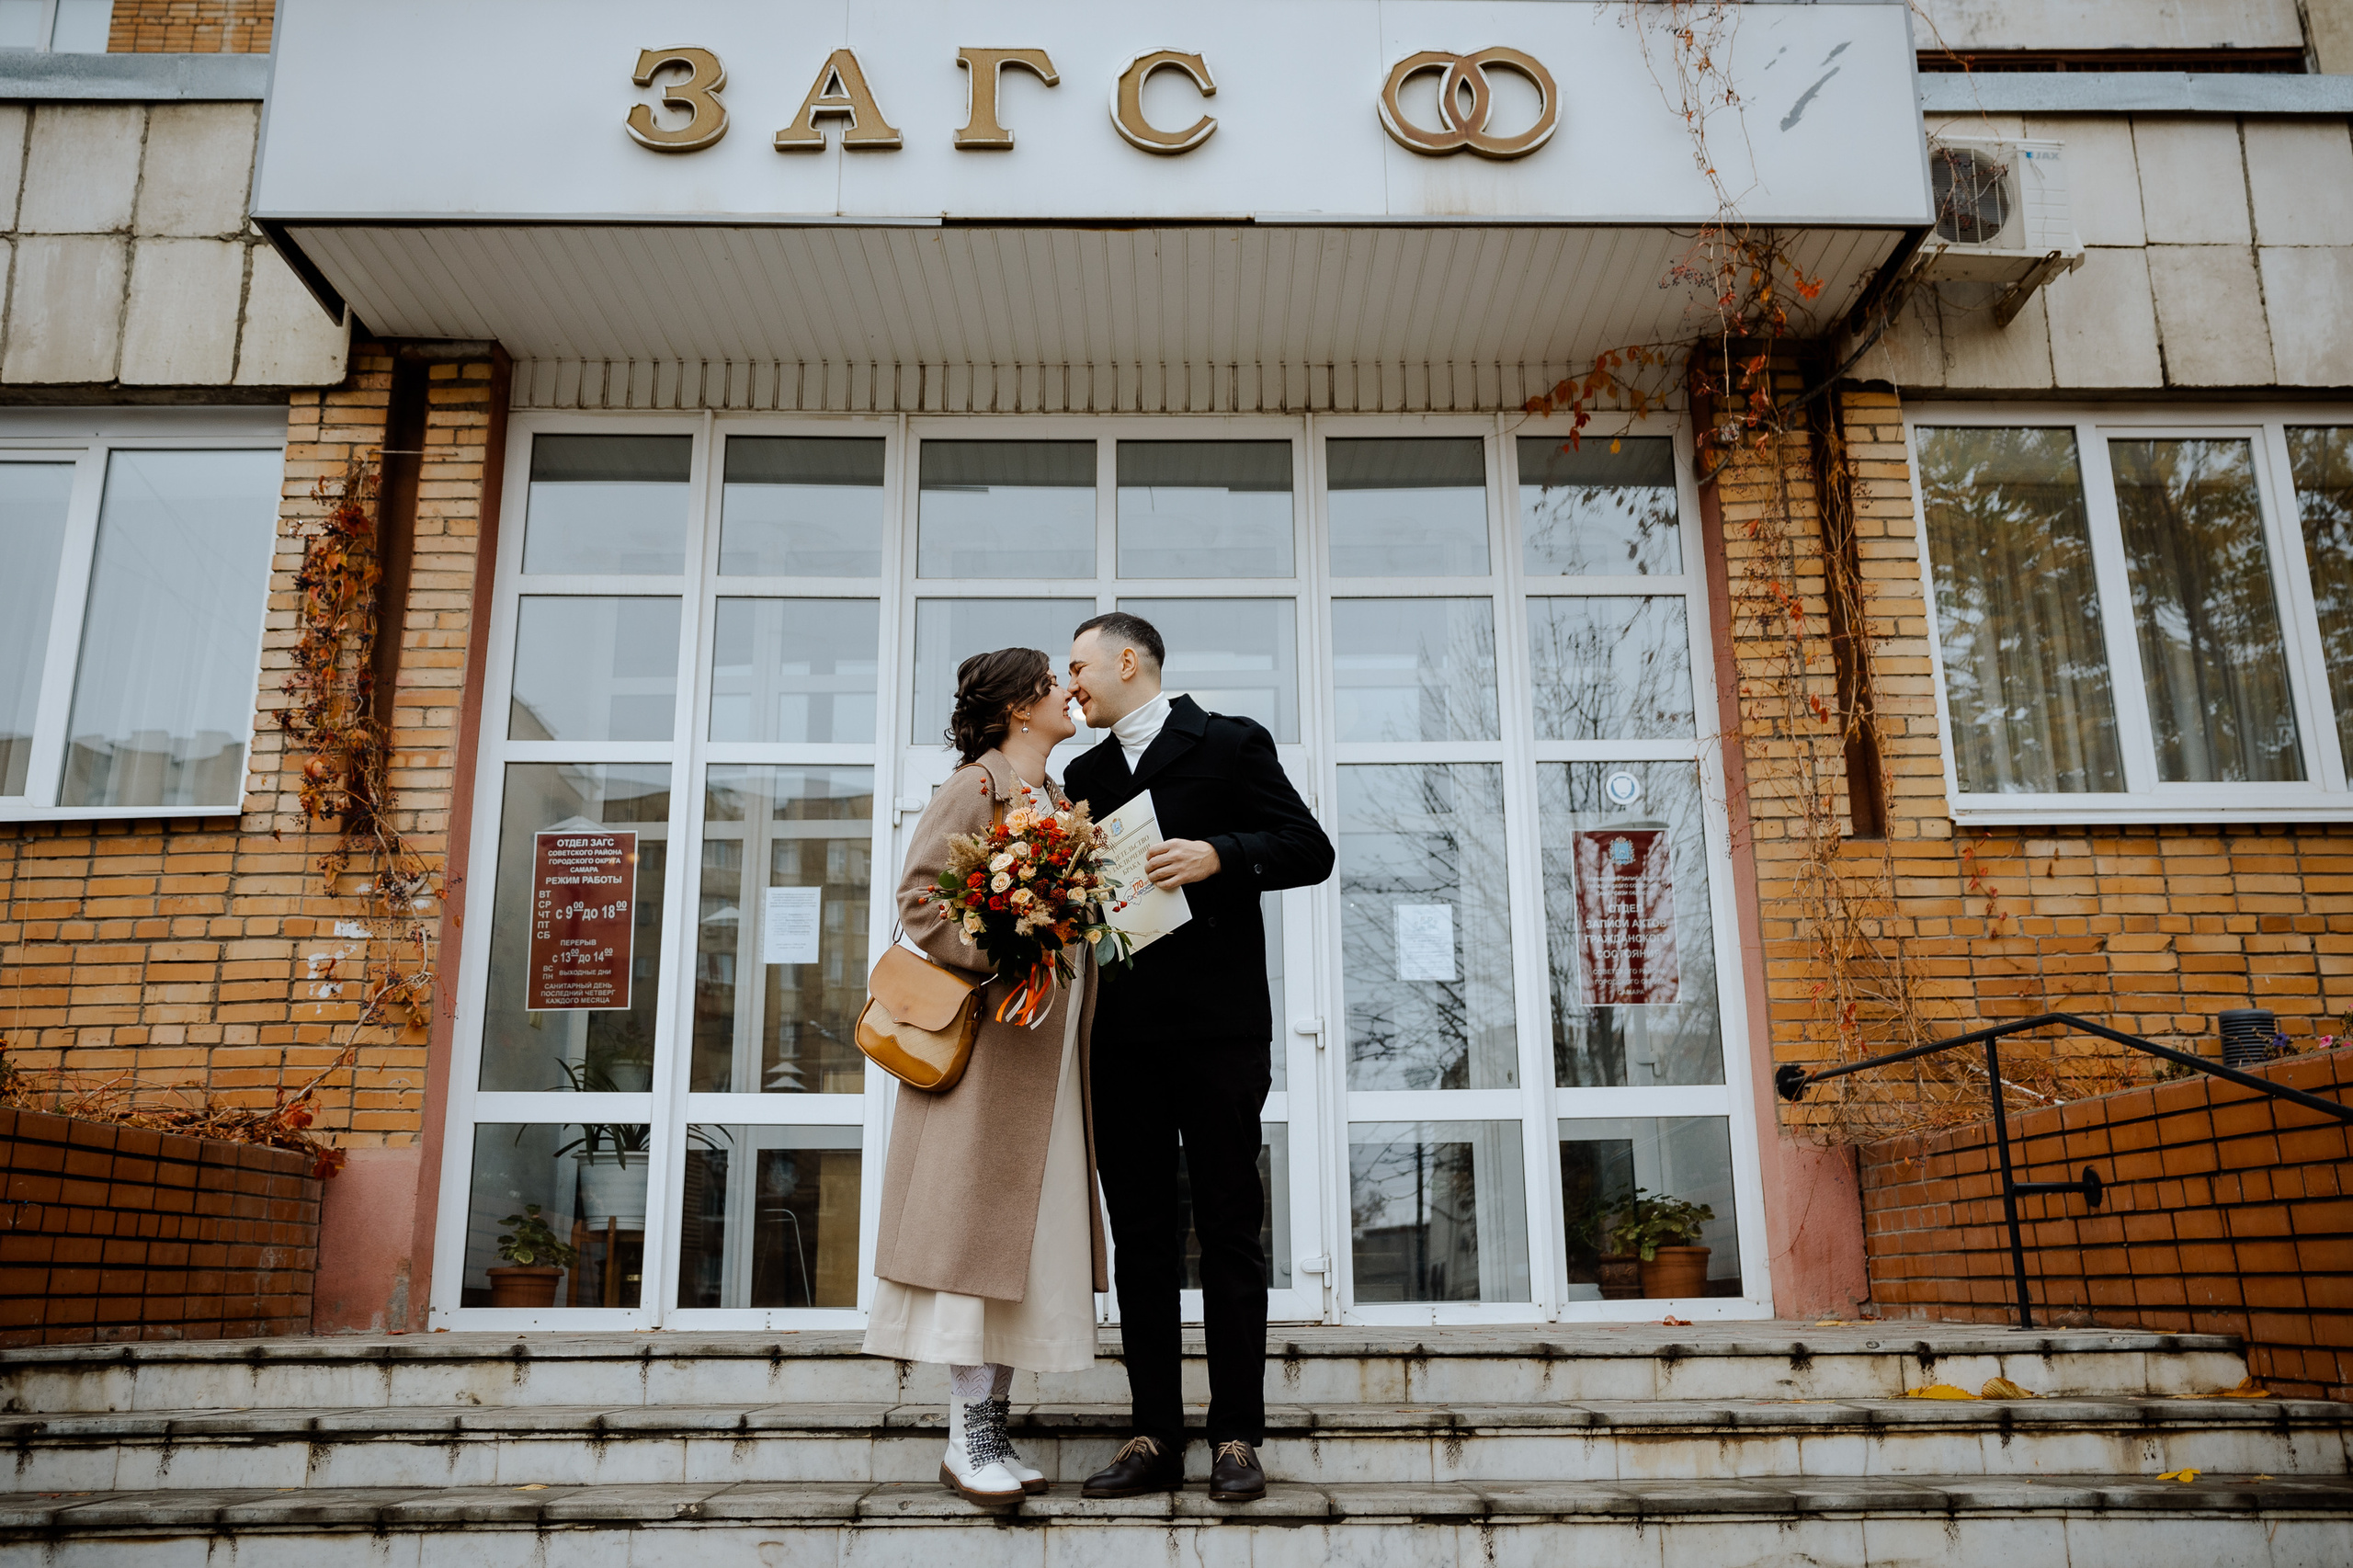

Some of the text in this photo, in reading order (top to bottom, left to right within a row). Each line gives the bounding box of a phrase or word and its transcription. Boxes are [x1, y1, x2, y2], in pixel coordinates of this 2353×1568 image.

[624, 43, 1220, 153] ЗАГС
[557, 838, 614, 847] ОТДЕЛ ЗАГС
[1123, 861, 1141, 876] БРАКА
[582, 876, 622, 884] РАБОТЫ
[1132, 880, 1143, 892] 170
[1608, 904, 1643, 914] ОТДЕЛ
[1586, 920, 1629, 928] ЗАПИСИ
[537, 931, 551, 939] СБ
[1585, 934, 1670, 944] ГРАЖДАНСКОГО
[1596, 949, 1661, 959] СОСТОЯНИЯ
